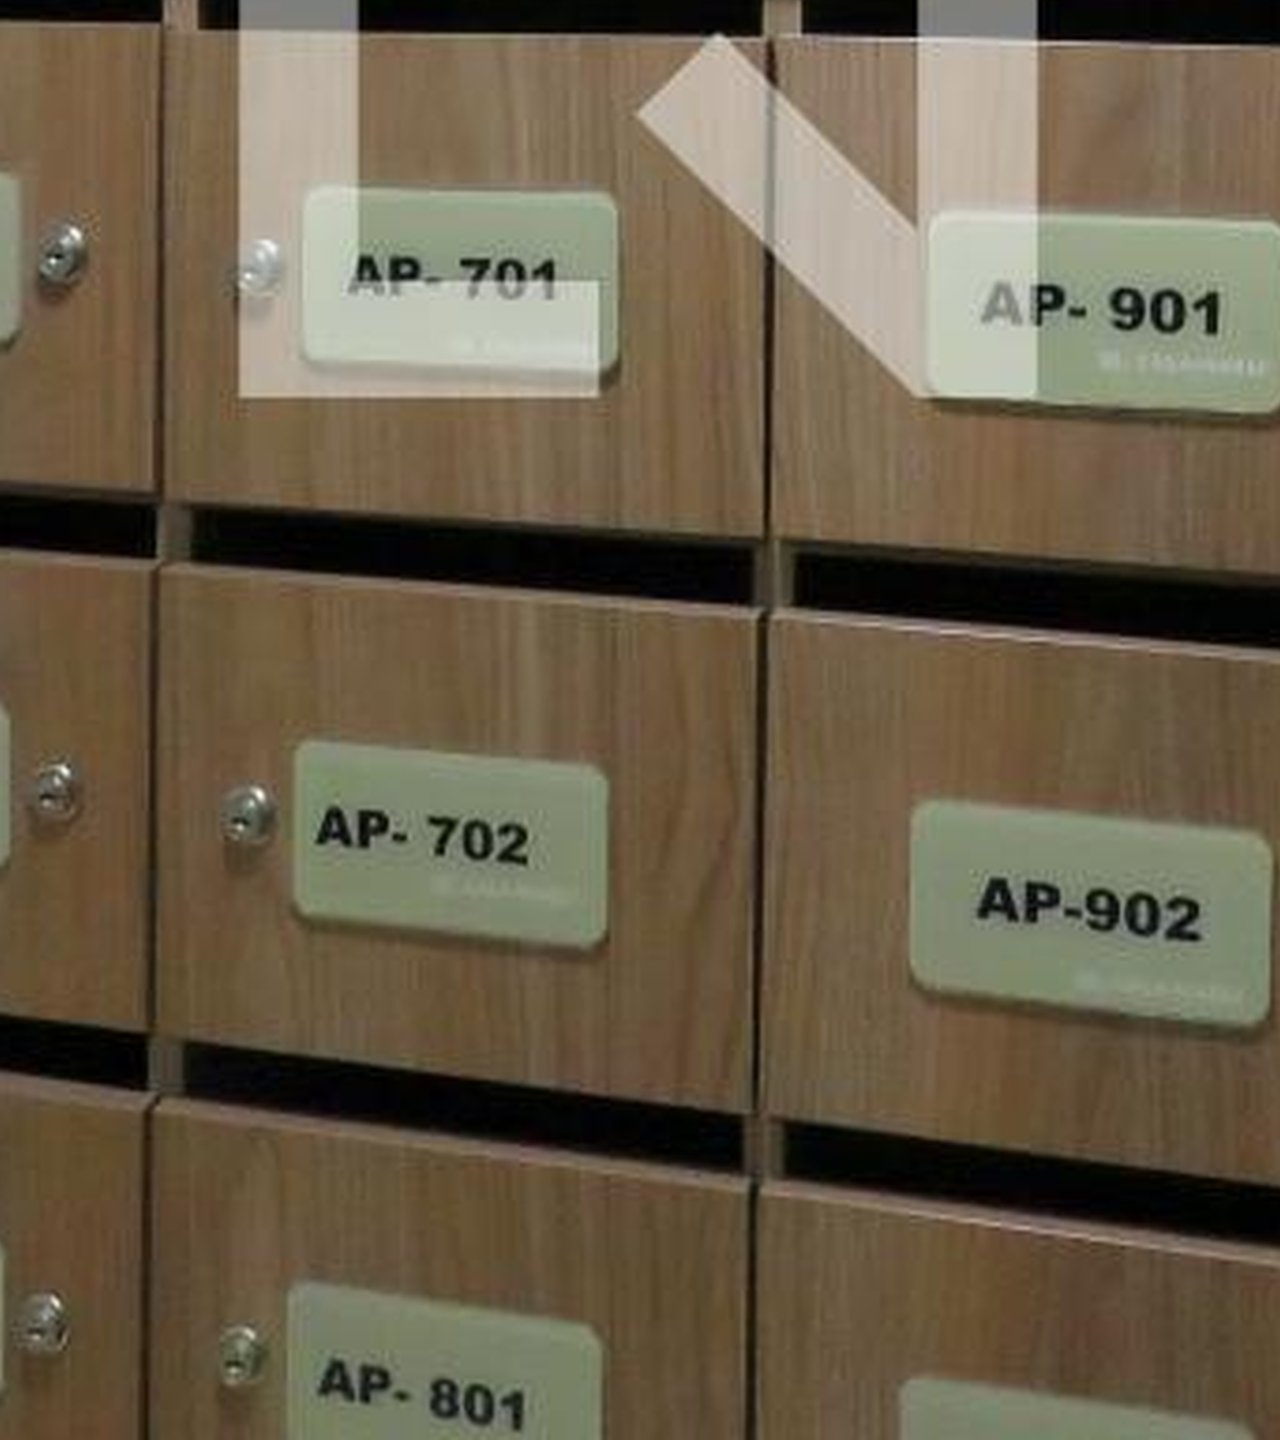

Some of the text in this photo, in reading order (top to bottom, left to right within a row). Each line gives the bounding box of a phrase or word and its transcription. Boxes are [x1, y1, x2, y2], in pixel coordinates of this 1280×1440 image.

[349, 254, 556, 300] AP- 701
[982, 281, 1220, 335] AP- 901
[316, 805, 531, 866] AP- 702
[977, 876, 1202, 942] AP-902
[317, 1357, 526, 1430] AP- 801
